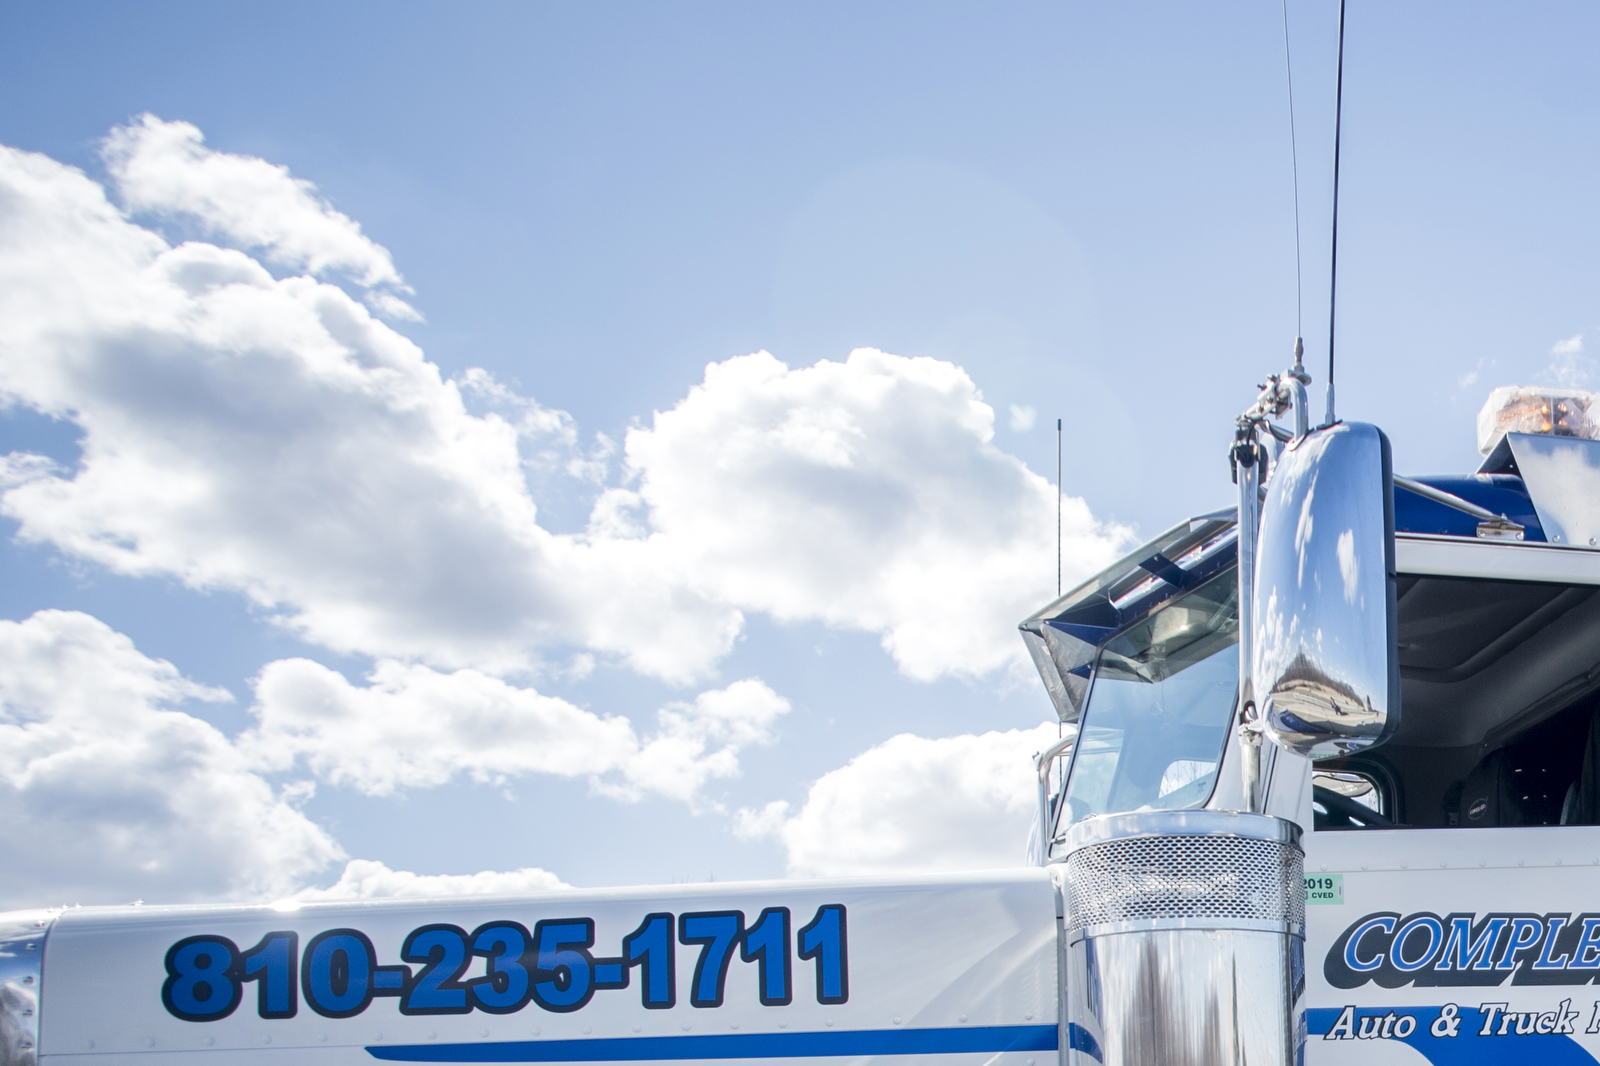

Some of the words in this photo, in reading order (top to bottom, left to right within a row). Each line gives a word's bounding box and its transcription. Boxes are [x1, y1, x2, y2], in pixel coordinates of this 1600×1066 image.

[162, 904, 847, 1022] 810-235-1711
[1323, 1005, 1417, 1040] Auto
[1430, 1003, 1462, 1038] &
[1477, 999, 1580, 1036] Truck
